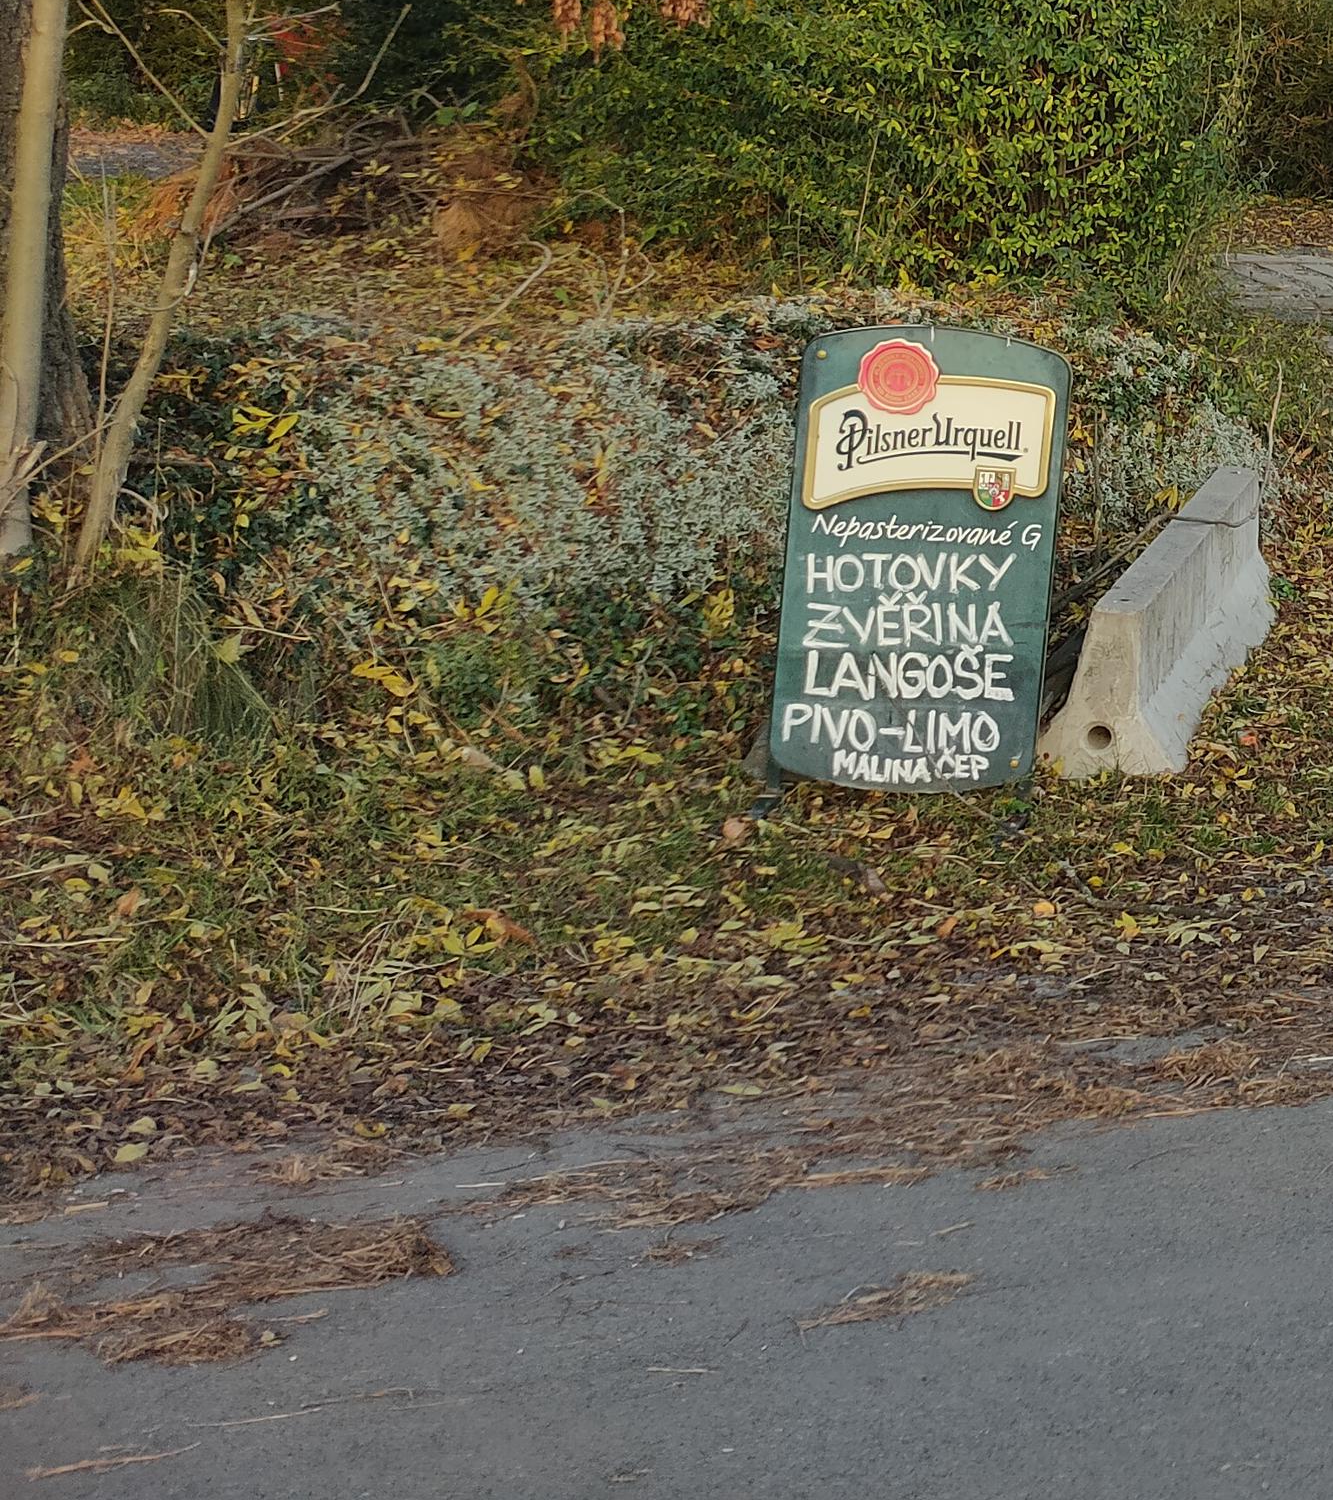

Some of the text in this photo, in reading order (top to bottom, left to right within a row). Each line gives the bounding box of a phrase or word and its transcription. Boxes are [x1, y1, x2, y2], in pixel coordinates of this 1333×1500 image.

[836, 409, 1022, 471] Pilsner Urquell
[811, 514, 1042, 550] Nepasterizované G
[806, 553, 1018, 594] HOTOVKY
[802, 590, 1014, 648] ZVĚŘINA
[804, 644, 1015, 701] LANGOŠE
[782, 703, 1000, 753] PIVO-LIMO
[833, 745, 989, 784] MALINA ČEP
